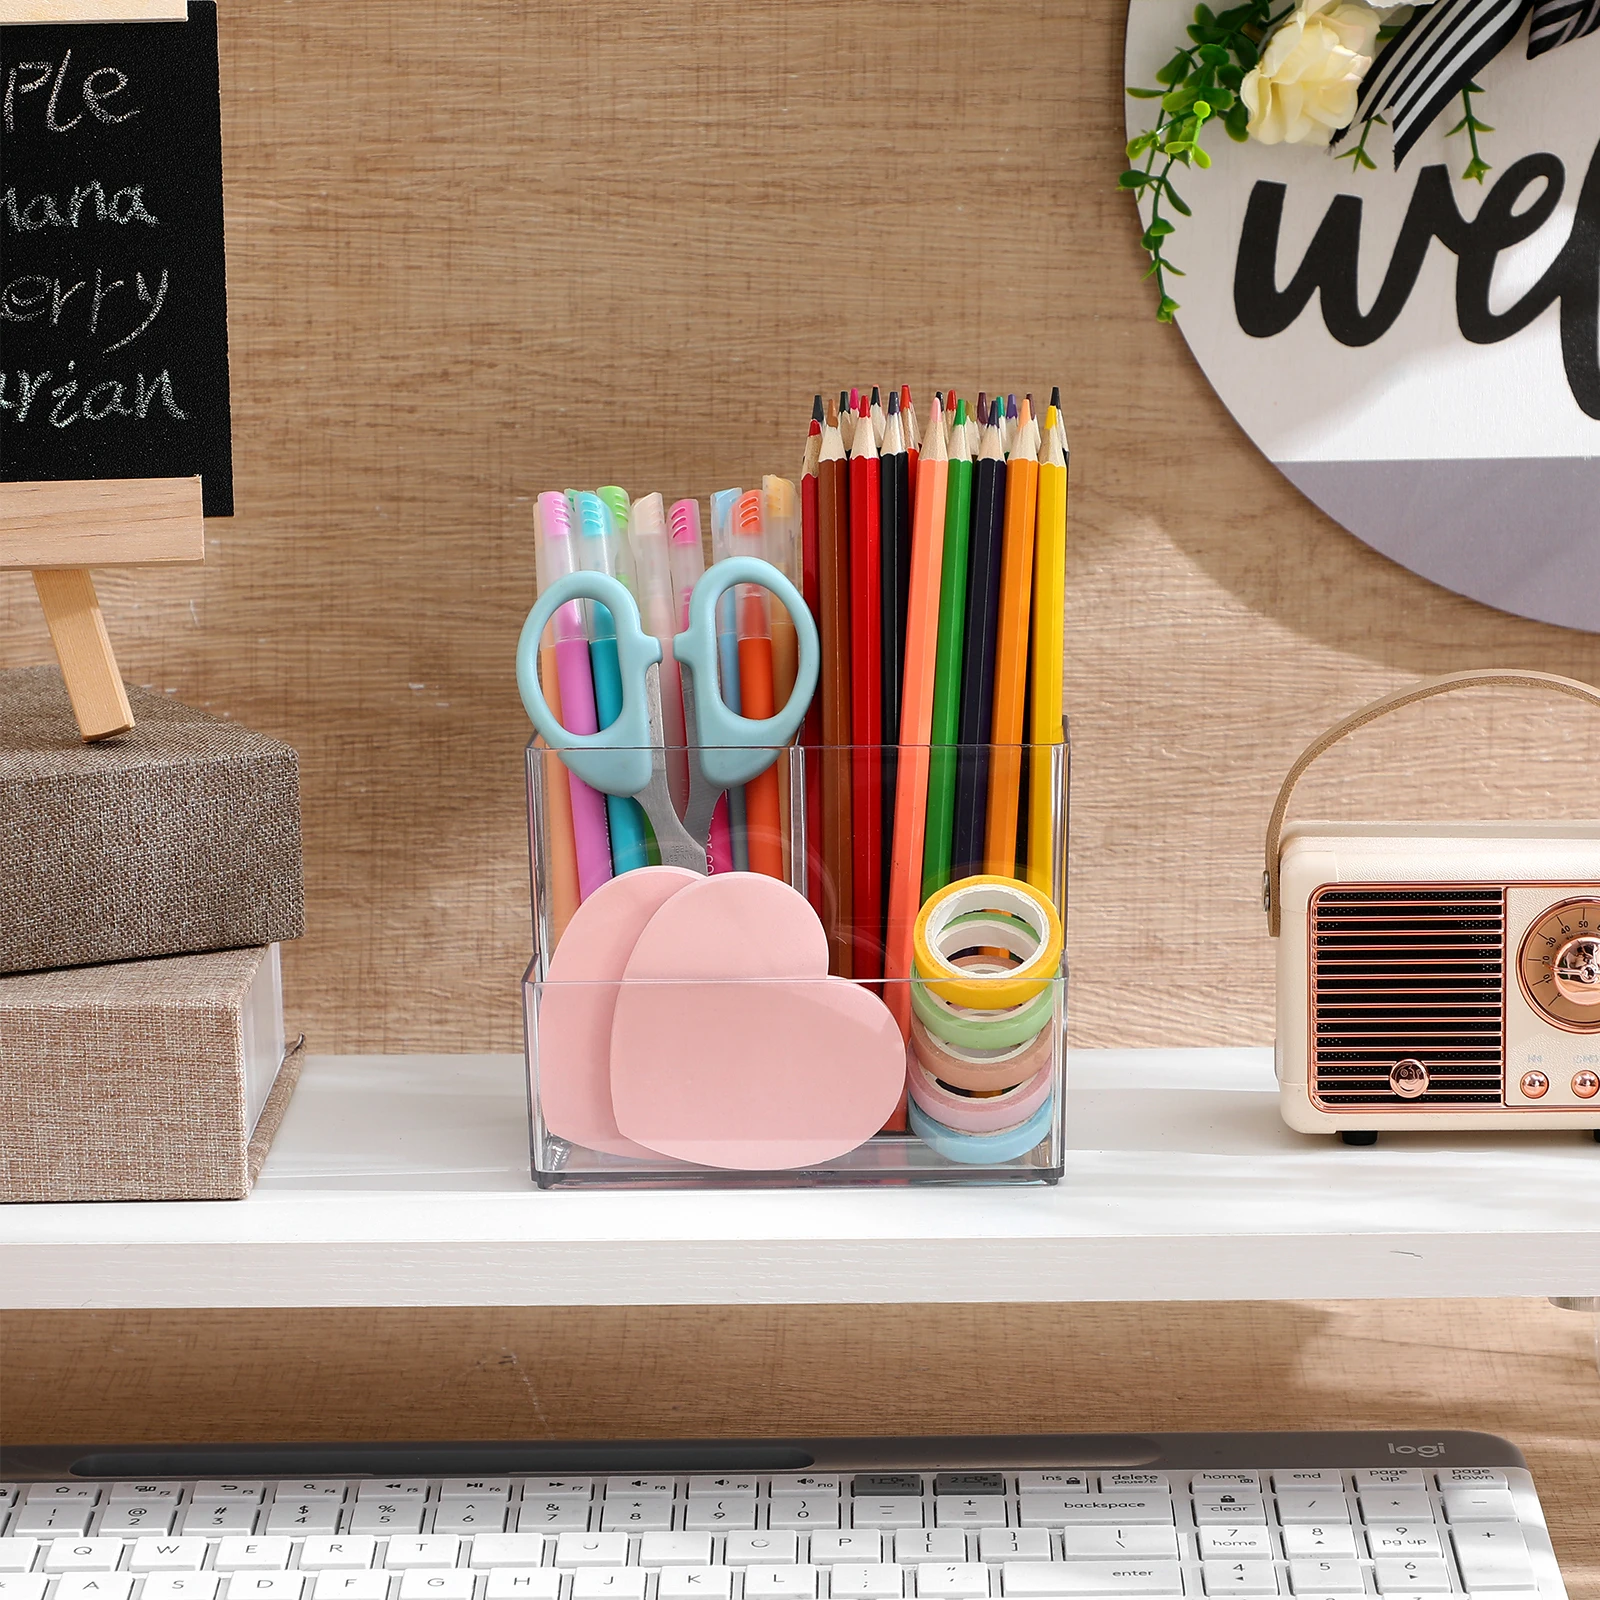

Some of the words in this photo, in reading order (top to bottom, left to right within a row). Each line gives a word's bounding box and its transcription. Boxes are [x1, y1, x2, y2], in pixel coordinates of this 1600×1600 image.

[1578, 920, 1589, 928] 50
[1560, 925, 1571, 935] 40
[1545, 936, 1557, 948] 30
[1388, 1443, 1445, 1457] logi
[1203, 1472, 1246, 1480] home
[1369, 1468, 1408, 1478] page
[1451, 1467, 1491, 1477] page
[950, 1476, 959, 1484] 2
[1111, 1473, 1159, 1482] delete
[1380, 1474, 1401, 1482] up
[1451, 1473, 1495, 1481] down
[298, 1504, 309, 1515] $
[377, 1504, 396, 1513] %
[545, 1503, 560, 1512] &
[1063, 1501, 1146, 1510] backspace
[1210, 1504, 1248, 1512] clear
[128, 1507, 148, 1518] @
[214, 1506, 227, 1515] #
[797, 1510, 810, 1519] 0
[294, 1516, 307, 1524] 4
[379, 1515, 391, 1524] 5
[462, 1514, 475, 1523] 6
[547, 1513, 558, 1522] 7
[629, 1512, 642, 1521] 8
[713, 1511, 726, 1520] 9
[47, 1519, 53, 1527] 1
[128, 1517, 141, 1526] 2
[211, 1517, 224, 1525] 3
[1227, 1528, 1238, 1537] 7
[1311, 1527, 1324, 1536] 8
[1395, 1526, 1408, 1536] 9
[838, 1538, 852, 1547] P
[73, 1546, 93, 1556] Q
[156, 1545, 180, 1555] W
[245, 1544, 258, 1554] E
[329, 1544, 343, 1553] R
[415, 1543, 428, 1552] T
[1232, 1563, 1244, 1572] 4
[1319, 1562, 1331, 1571] 5
[1404, 1561, 1417, 1570] 6
[427, 1577, 445, 1587] G
[513, 1576, 531, 1586] H
[603, 1575, 614, 1585] J
[687, 1574, 701, 1584] K
[773, 1573, 785, 1583] L
[82, 1581, 100, 1590] A
[171, 1579, 185, 1590] S
[256, 1579, 274, 1589] D
[344, 1578, 357, 1588] F
